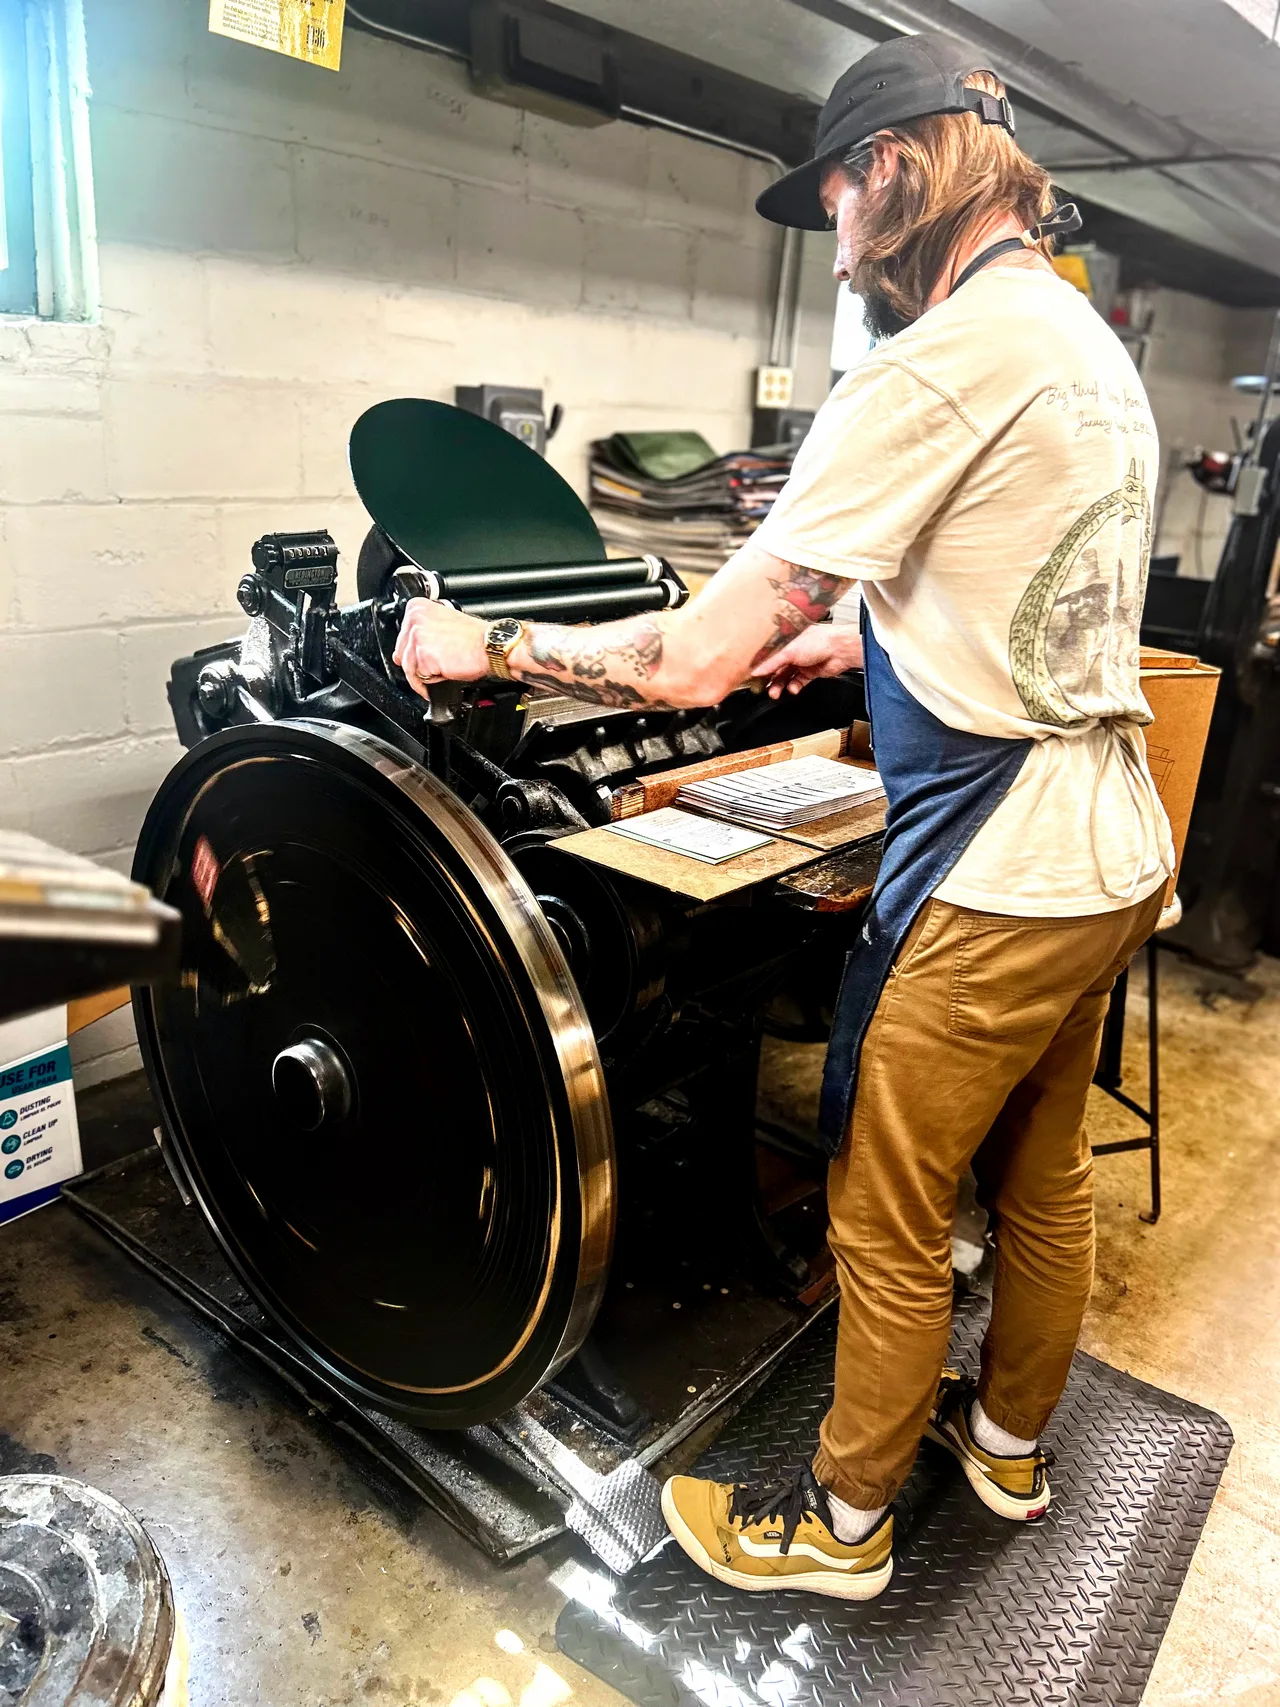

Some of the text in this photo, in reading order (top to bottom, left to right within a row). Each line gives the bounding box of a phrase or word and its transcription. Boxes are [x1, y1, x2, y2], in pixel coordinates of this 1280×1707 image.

[1046, 386, 1069, 411] Big
[1074, 410, 1112, 437] January
[28, 1060, 56, 1080] FOR
[11, 1073, 57, 1095] USAR PARA
[20, 1096, 51, 1114] DUSTING
[22, 1118, 59, 1140] CLEAN UP
[26, 1146, 53, 1164] DRYING
[807, 1488, 817, 1506] VANS
